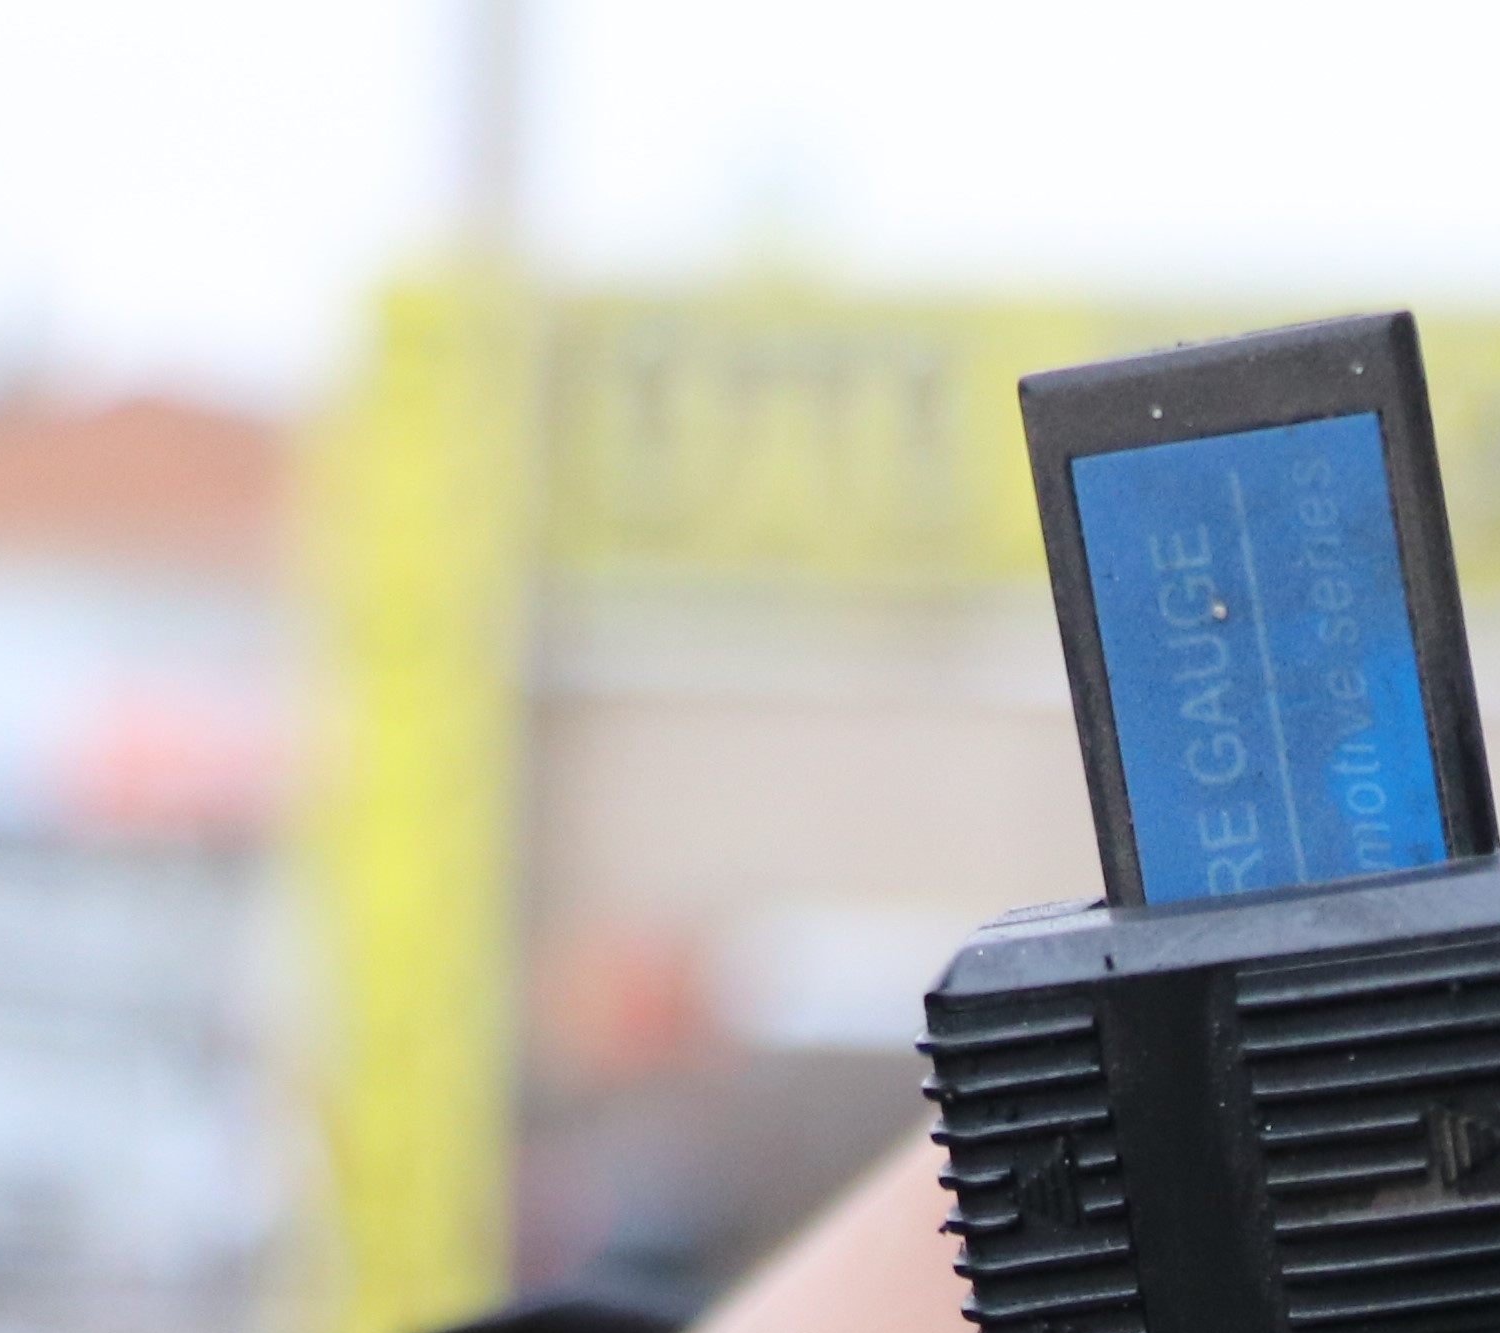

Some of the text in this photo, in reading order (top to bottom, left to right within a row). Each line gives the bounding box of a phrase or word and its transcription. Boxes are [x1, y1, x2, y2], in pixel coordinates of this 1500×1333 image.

[1292, 455, 1362, 645] series
[1149, 521, 1264, 897] RE GAUGE
